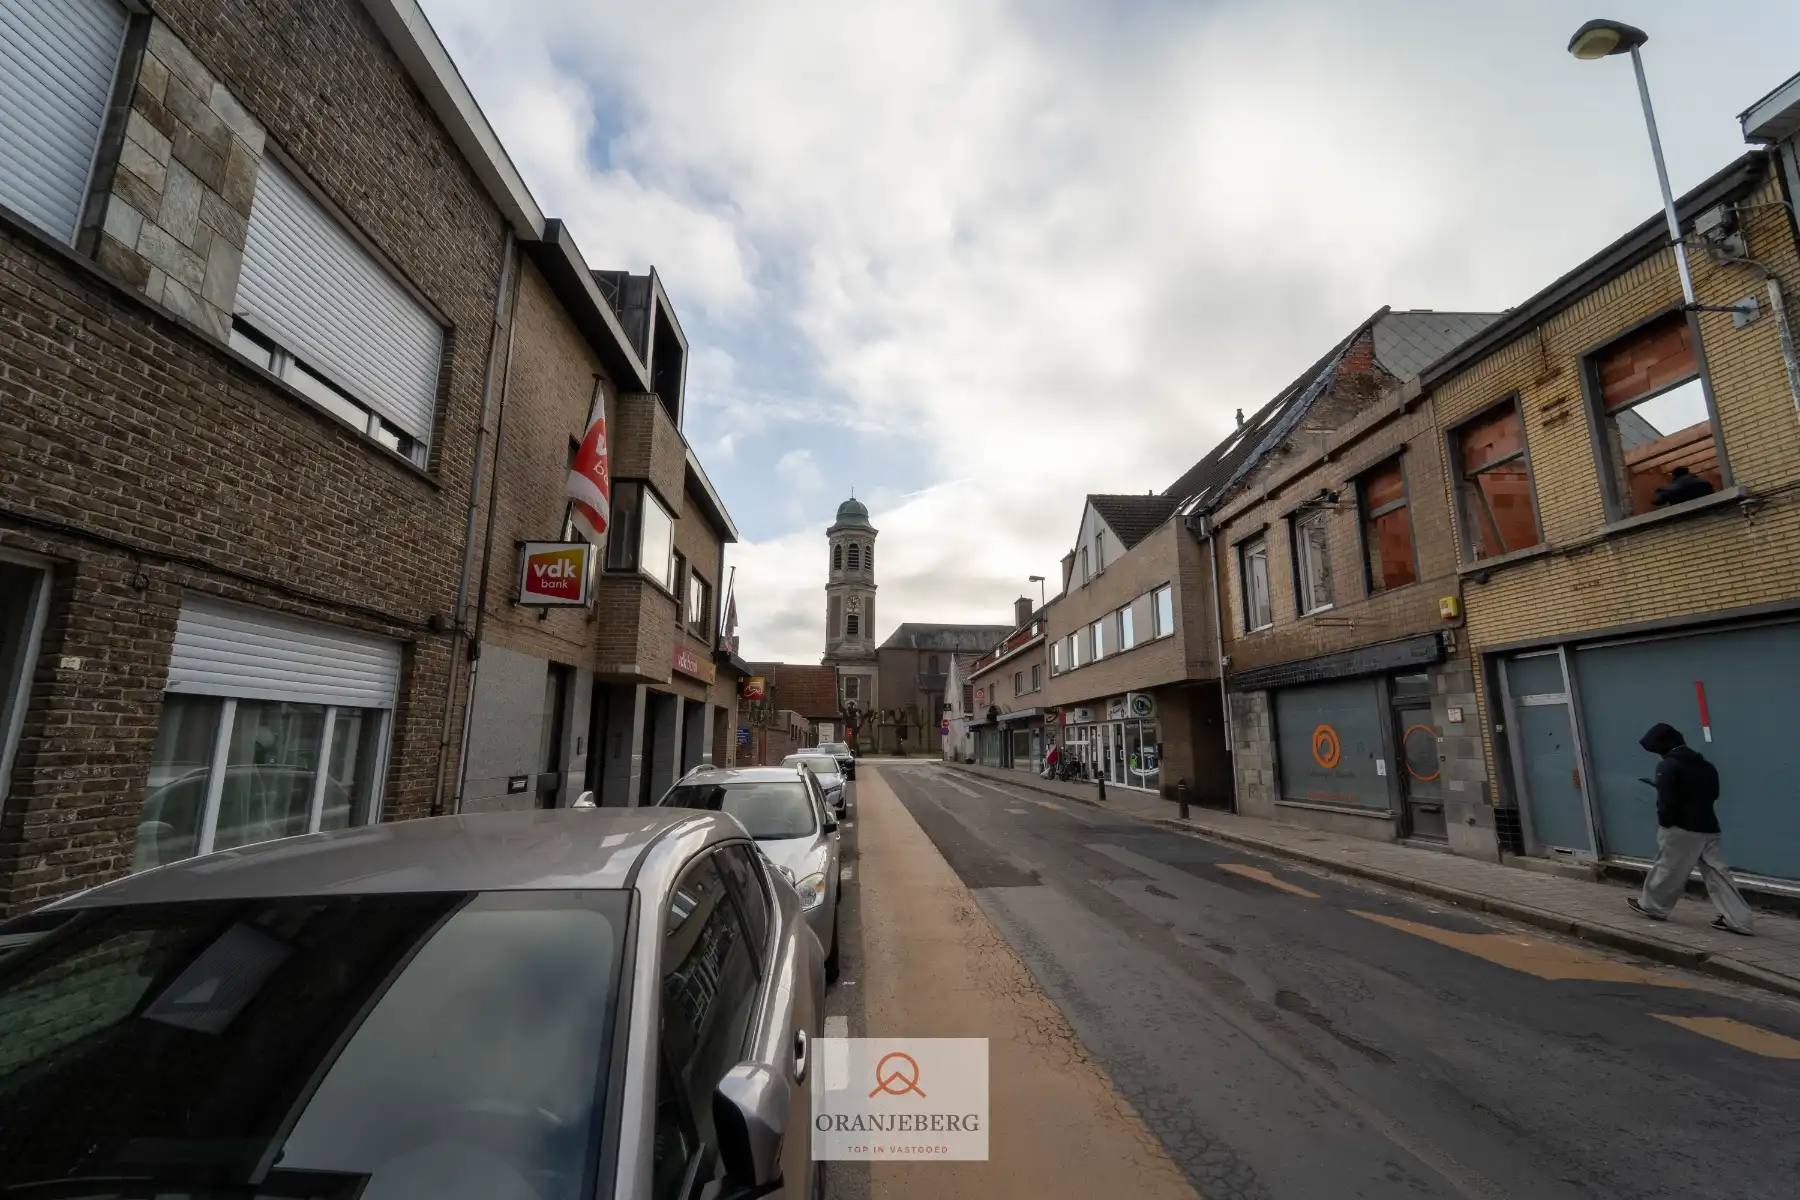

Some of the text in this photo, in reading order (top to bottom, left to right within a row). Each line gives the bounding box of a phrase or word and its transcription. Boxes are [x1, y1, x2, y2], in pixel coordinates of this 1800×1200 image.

[533, 558, 577, 578] vdk
[541, 579, 569, 589] bank
[677, 651, 687, 669] vdk
